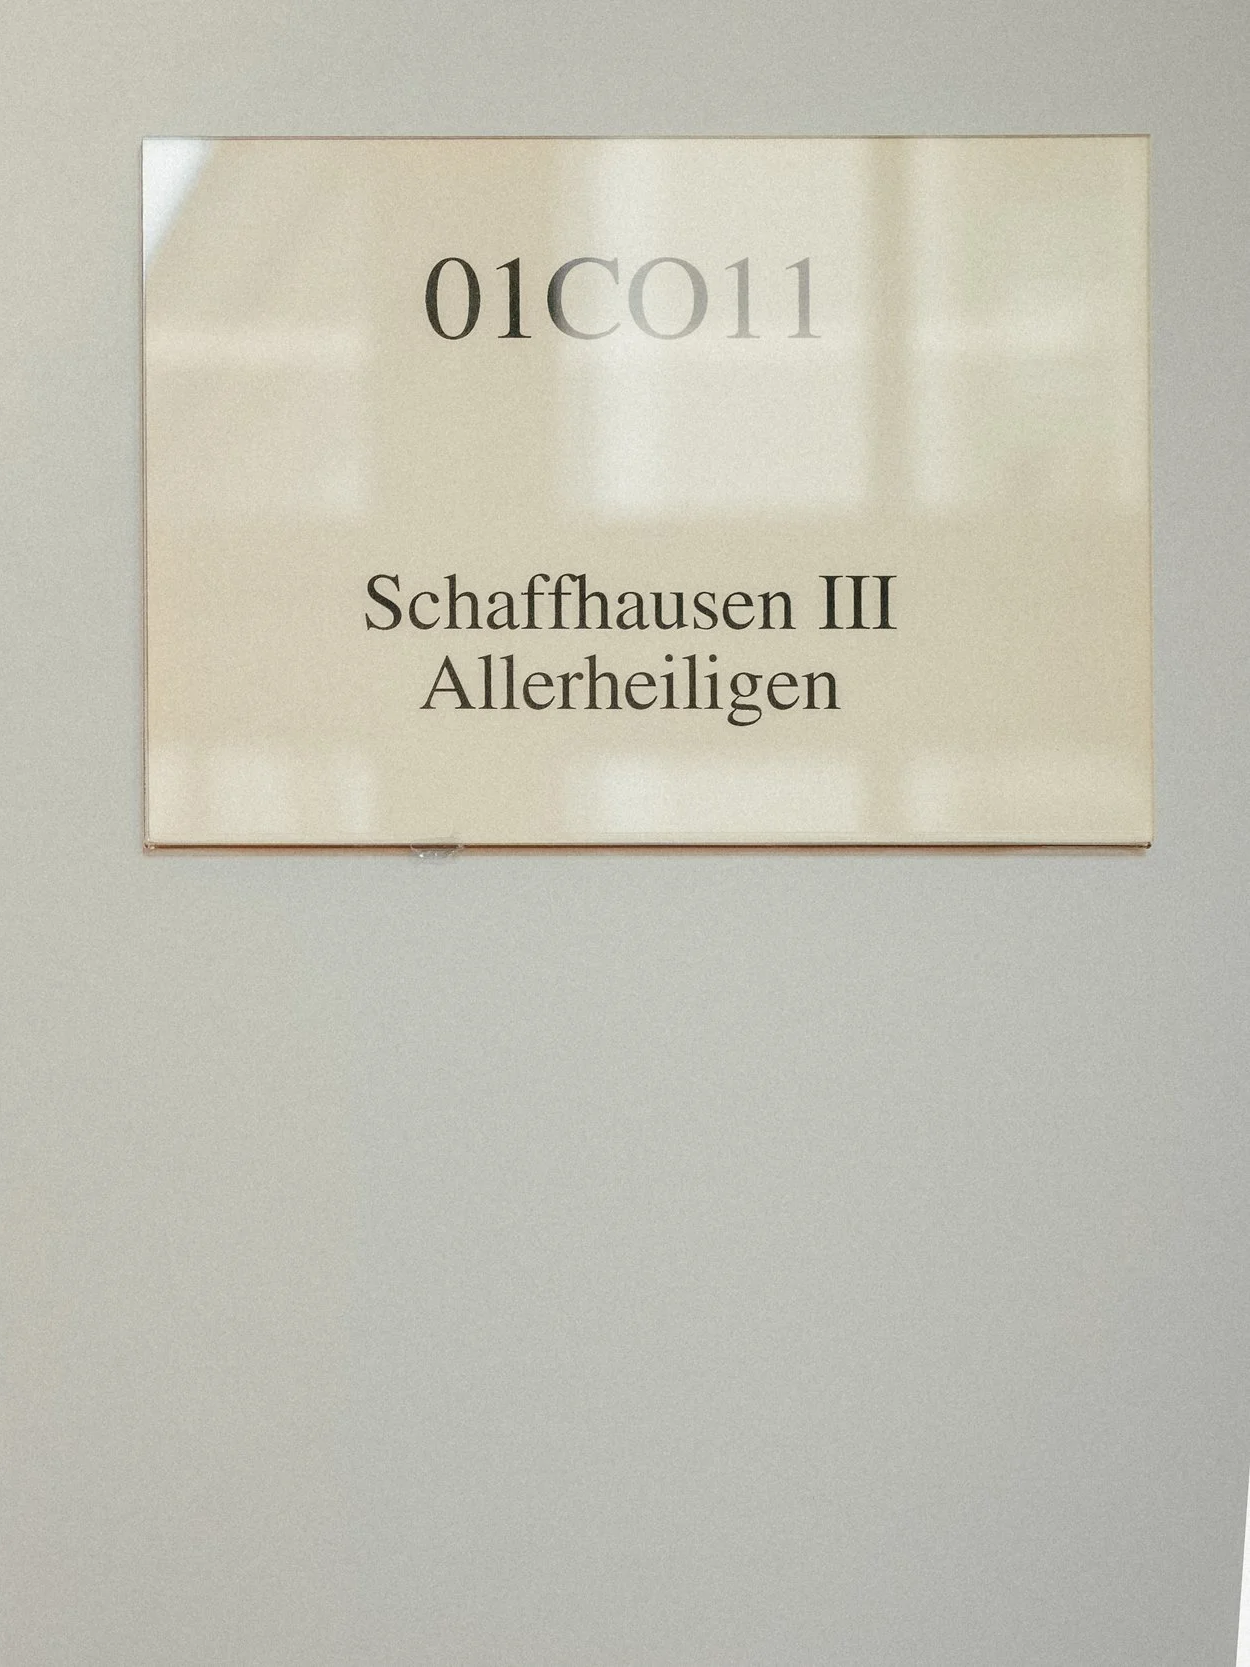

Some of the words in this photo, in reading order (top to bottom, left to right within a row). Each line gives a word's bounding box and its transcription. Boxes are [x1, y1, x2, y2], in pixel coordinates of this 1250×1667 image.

[424, 256, 821, 341] 01CO11
[364, 572, 797, 632] Schaffhausen
[818, 574, 898, 631] III
[419, 653, 842, 728] Allerheiligen
